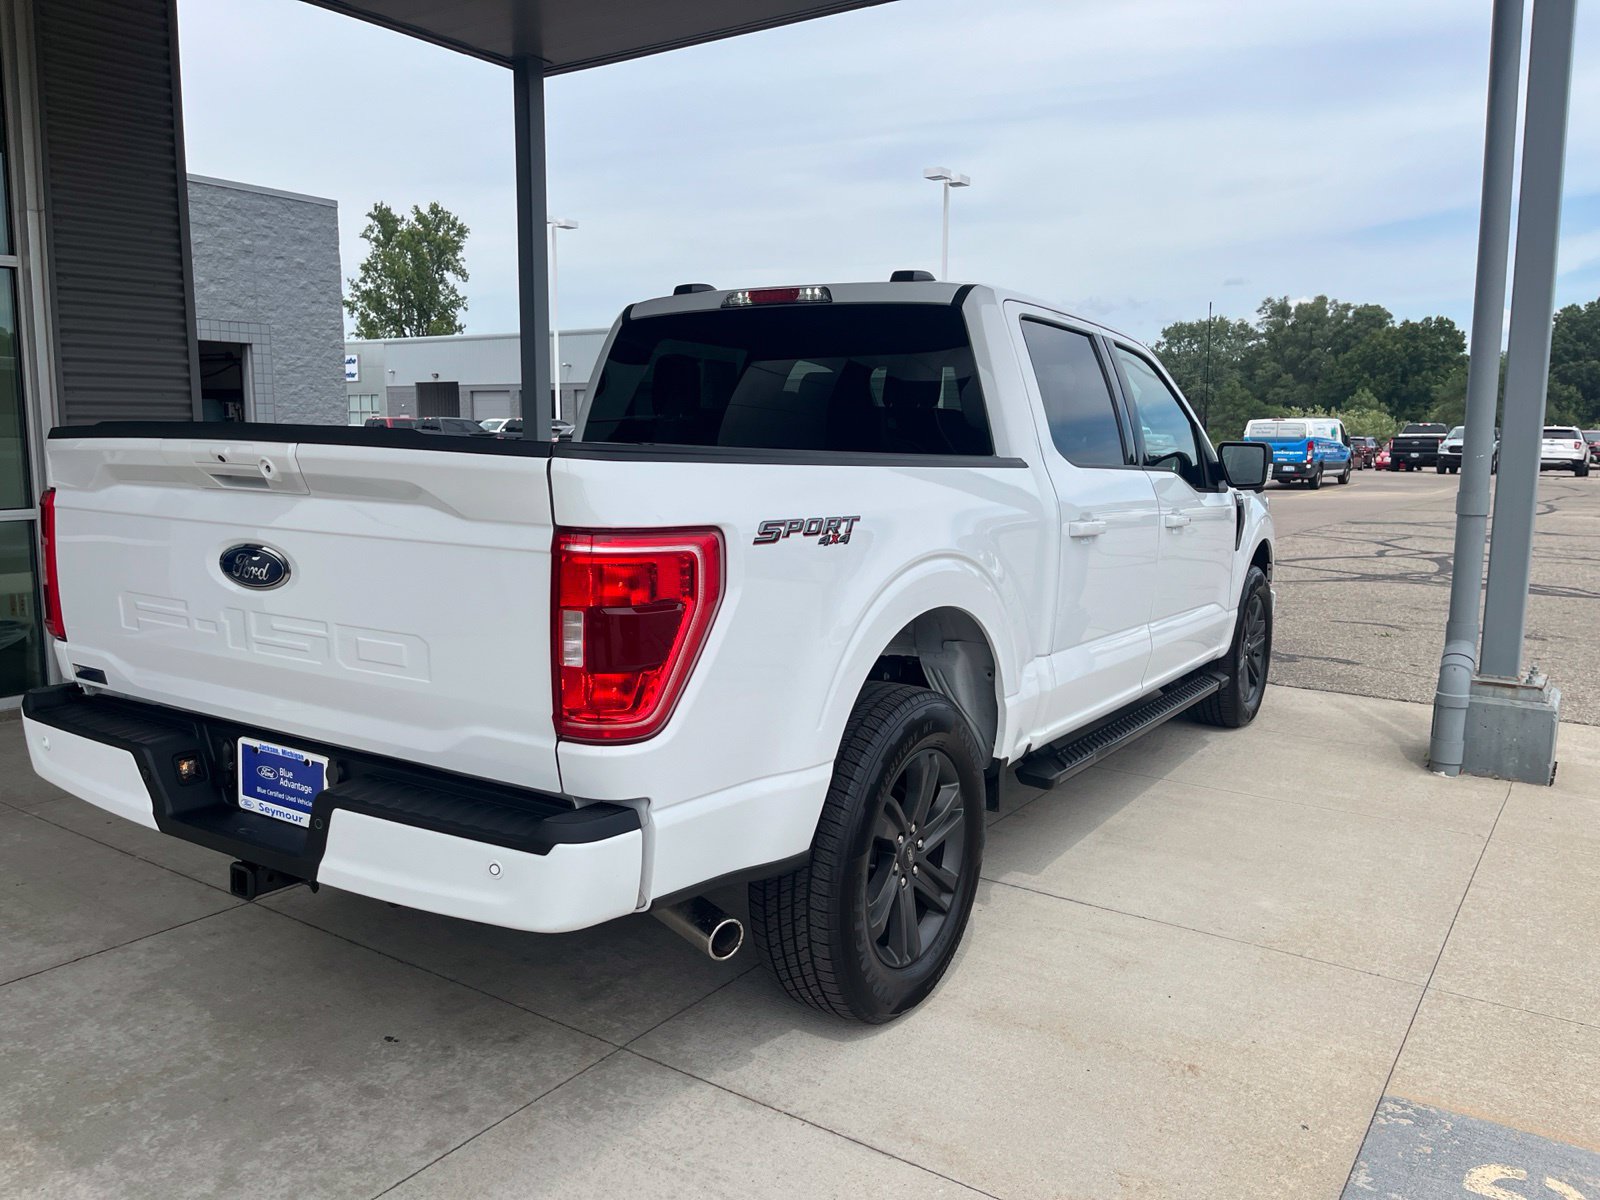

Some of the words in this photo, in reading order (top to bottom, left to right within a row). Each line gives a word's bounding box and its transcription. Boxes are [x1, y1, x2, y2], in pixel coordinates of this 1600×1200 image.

[753, 515, 861, 545] SPORT
[232, 552, 270, 581] Ford
[118, 590, 432, 683] F-150
[281, 748, 304, 761] Michigan
[260, 766, 275, 778] Ford
[279, 767, 294, 779] Blue
[256, 786, 267, 795] Blue
[266, 789, 285, 800] Certified
[285, 794, 297, 803] Used
[279, 777, 313, 795] Advantage
[258, 802, 304, 823] Seymour
